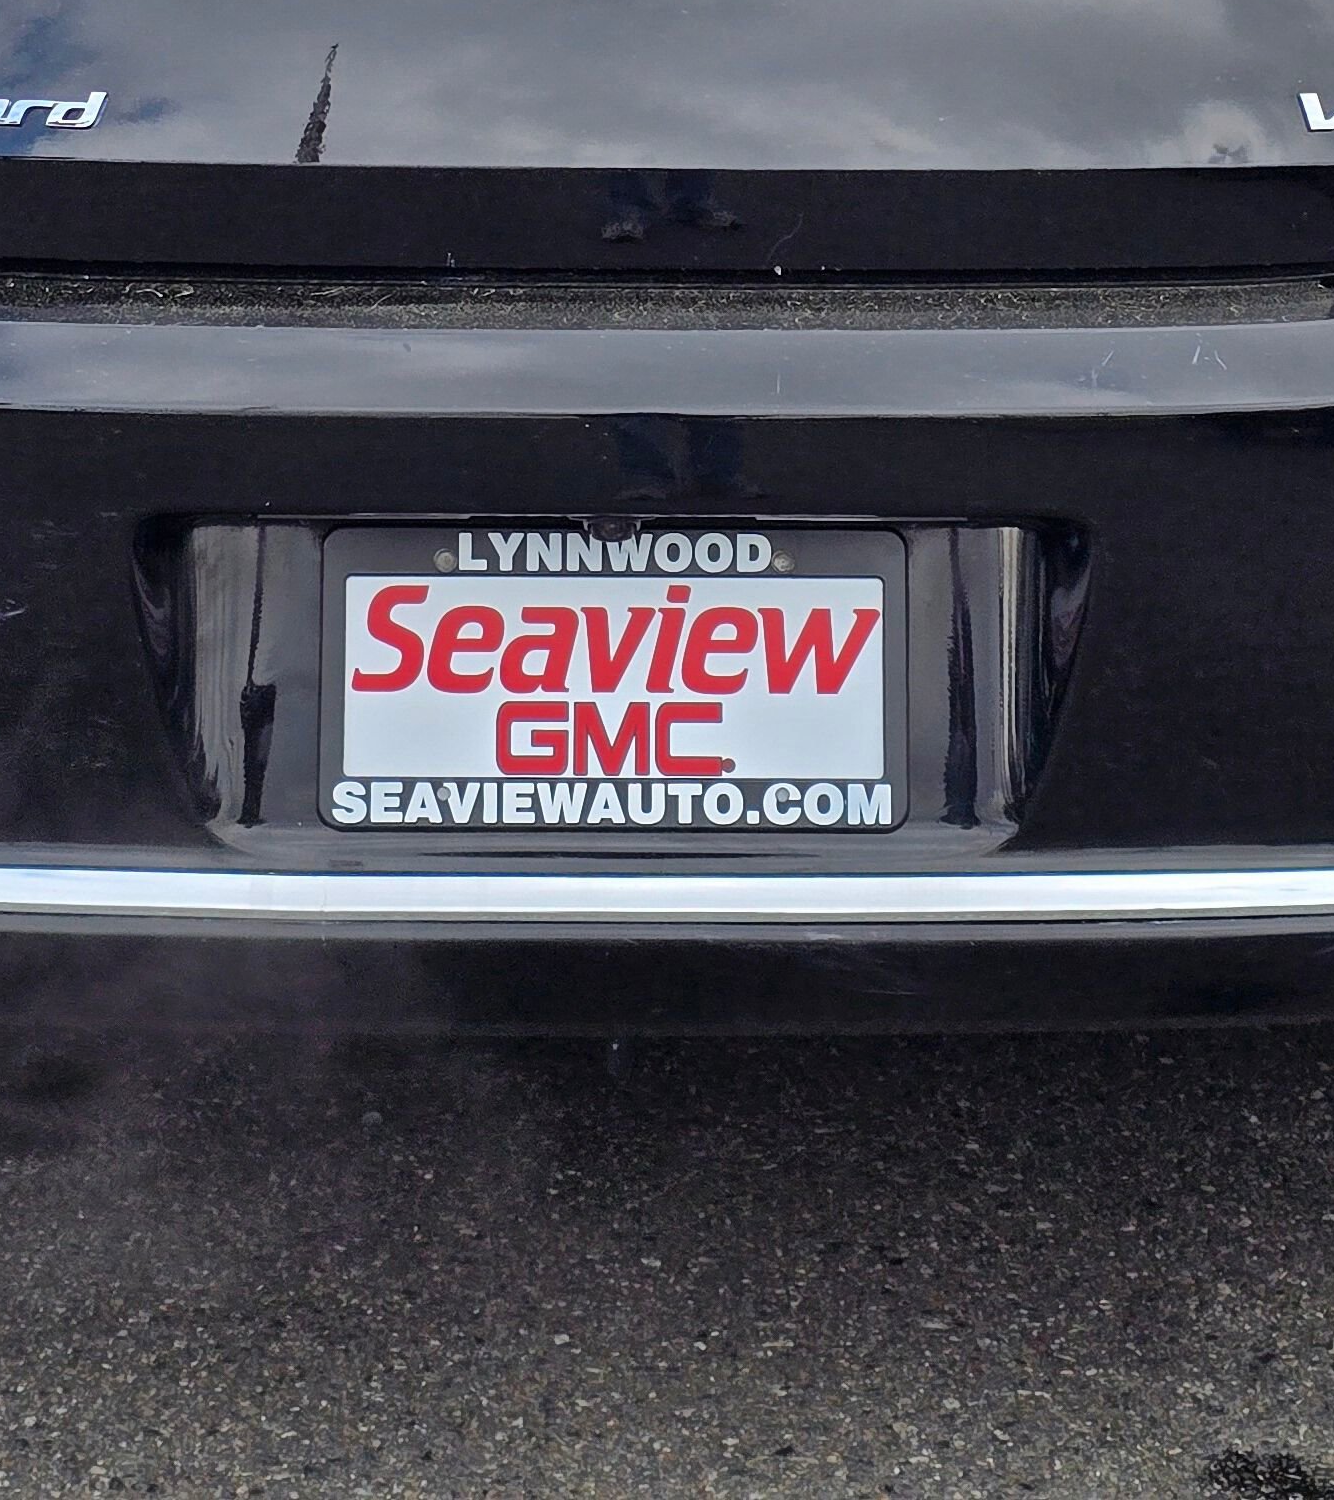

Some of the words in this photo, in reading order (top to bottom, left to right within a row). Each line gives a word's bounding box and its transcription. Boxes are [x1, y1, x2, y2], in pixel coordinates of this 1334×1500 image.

[458, 532, 771, 573] LYNNWOOD
[351, 585, 880, 695] Seaview
[496, 701, 724, 776] GMC
[332, 782, 892, 826] SEAVIEWAUTO.COM
